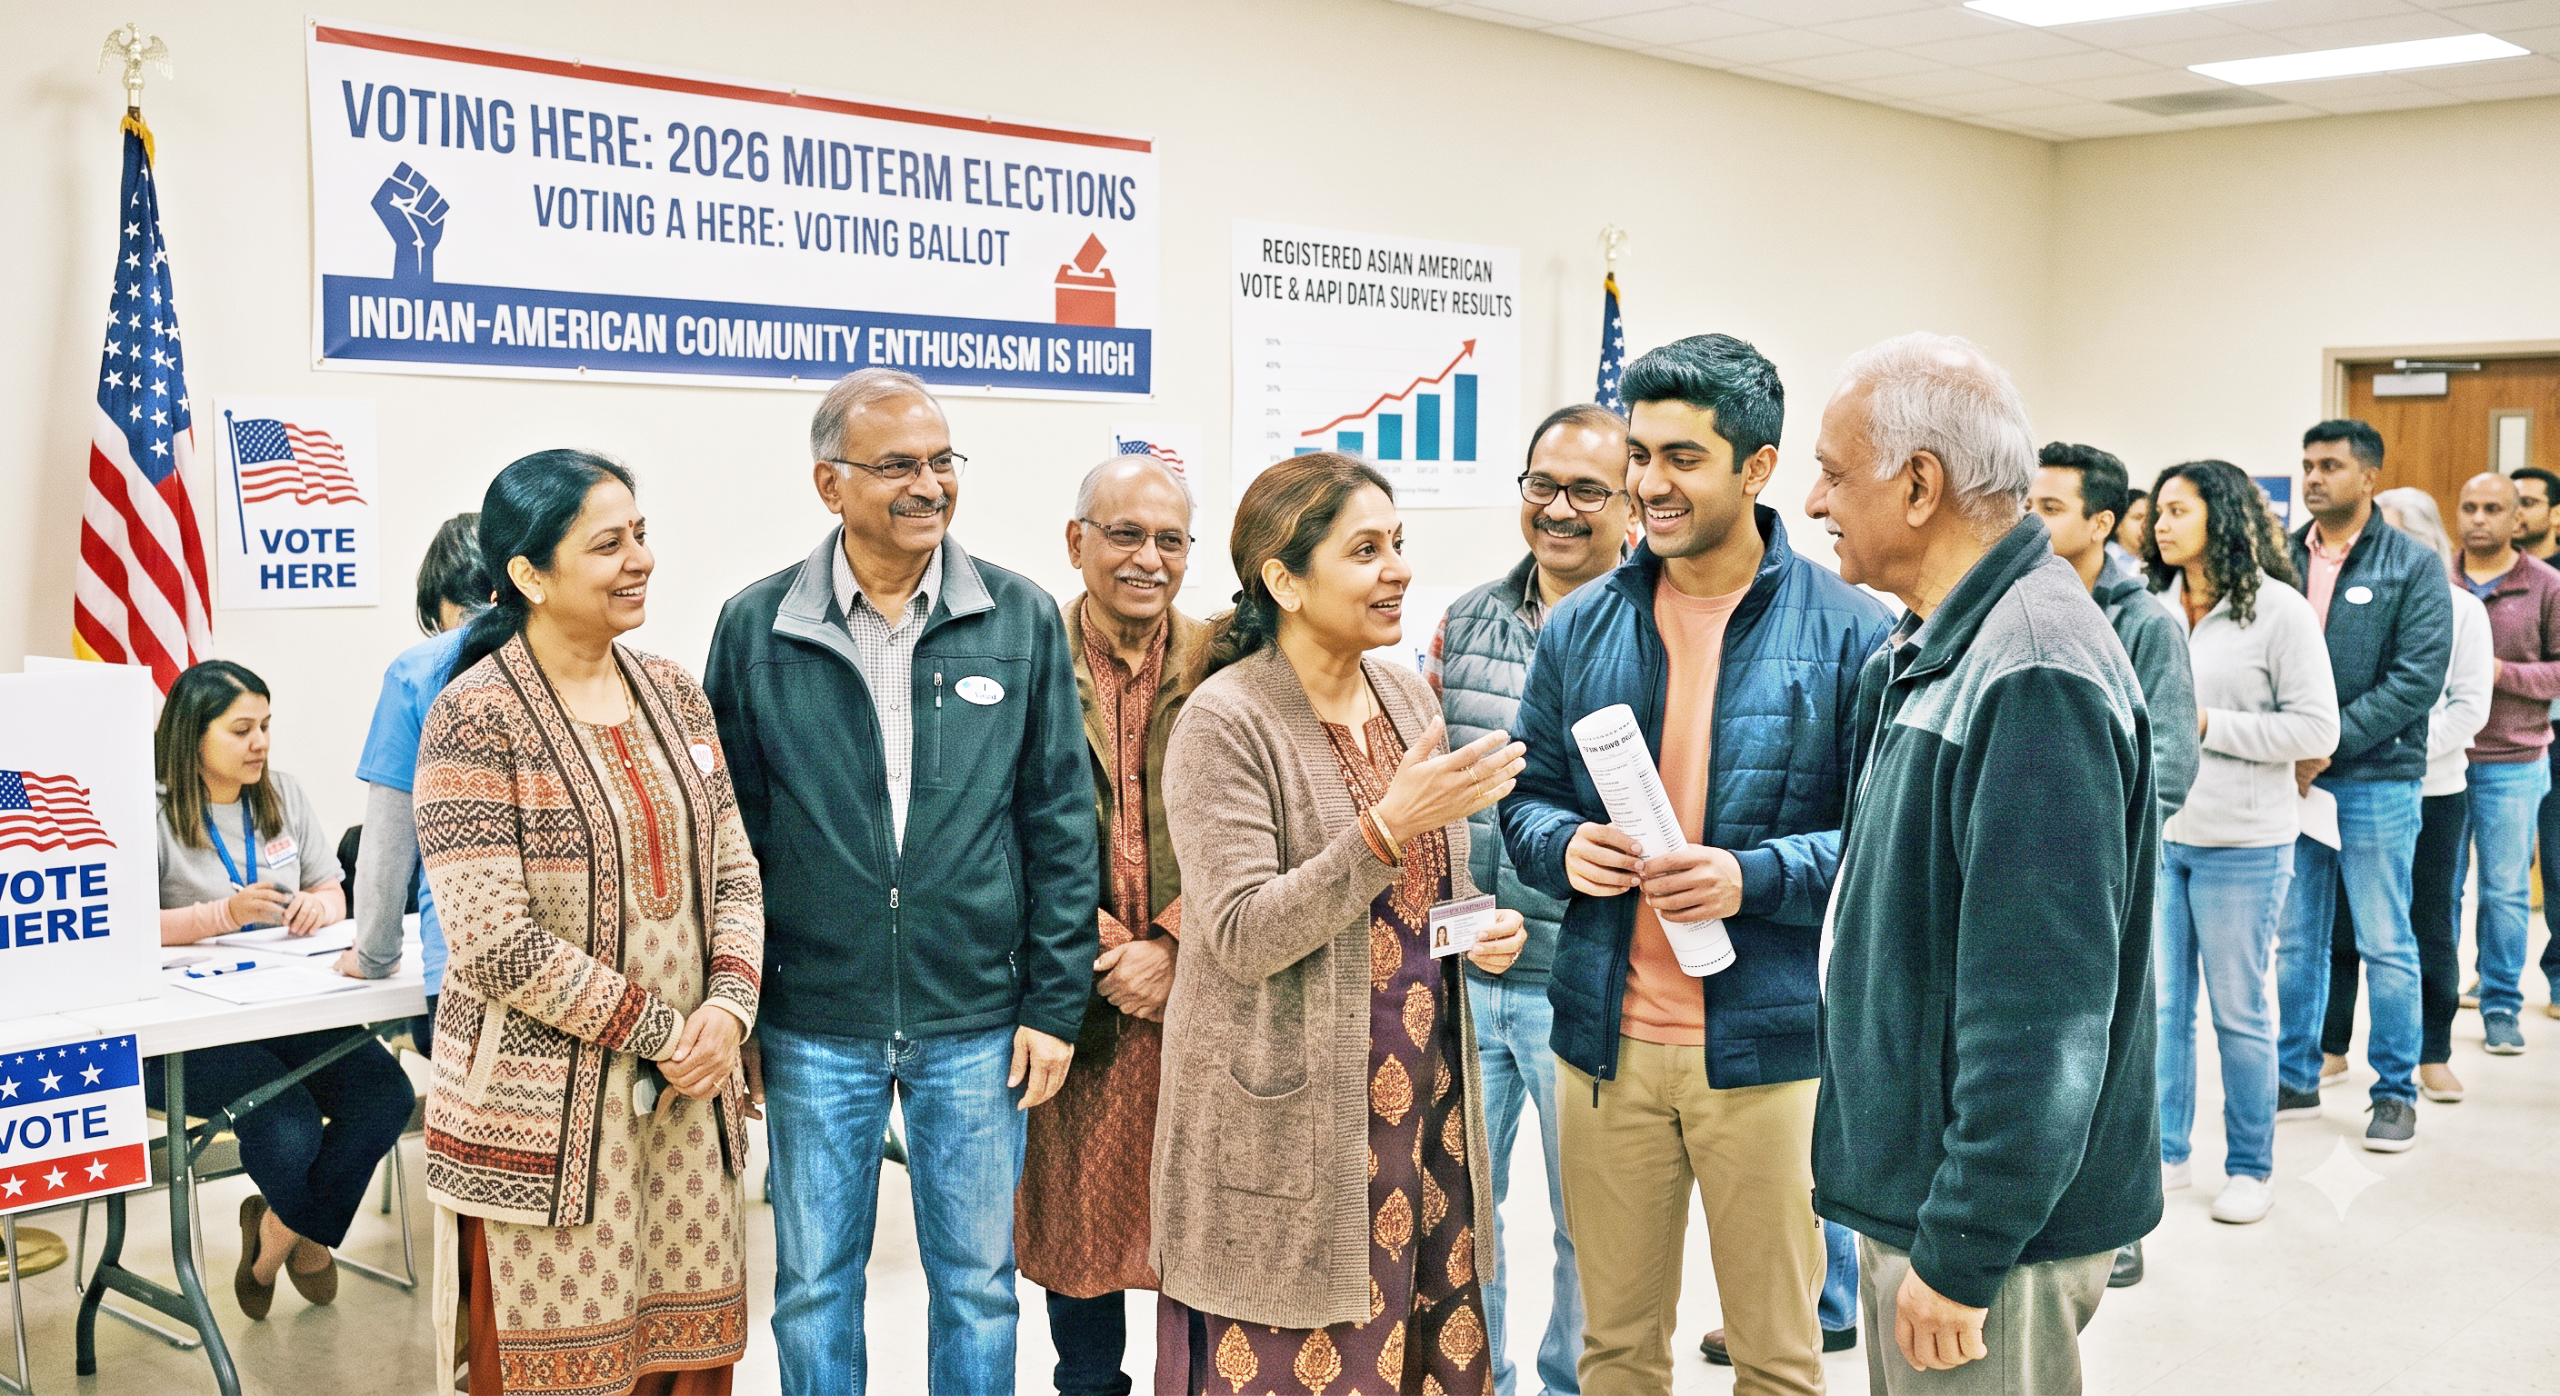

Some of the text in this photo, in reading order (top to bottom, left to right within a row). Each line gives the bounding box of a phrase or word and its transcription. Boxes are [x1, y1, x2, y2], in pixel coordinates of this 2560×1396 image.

[341, 80, 1136, 221] VOTING HERE: 2026 MIDTERM ELECTIONS
[533, 184, 1010, 267] VOTING A HERE: VOTING BALLOT
[1262, 238, 1492, 283] REGISTERED ASIAN AMERICAN
[1240, 272, 1512, 318] VOTE & AAPI DATA SURVEY RESULTS
[349, 294, 1135, 377] INDIAN-AMERICAN COMMUNITY ENTHUSIASM IS HIGH
[260, 528, 356, 554] VOTE
[260, 563, 357, 590] HERE
